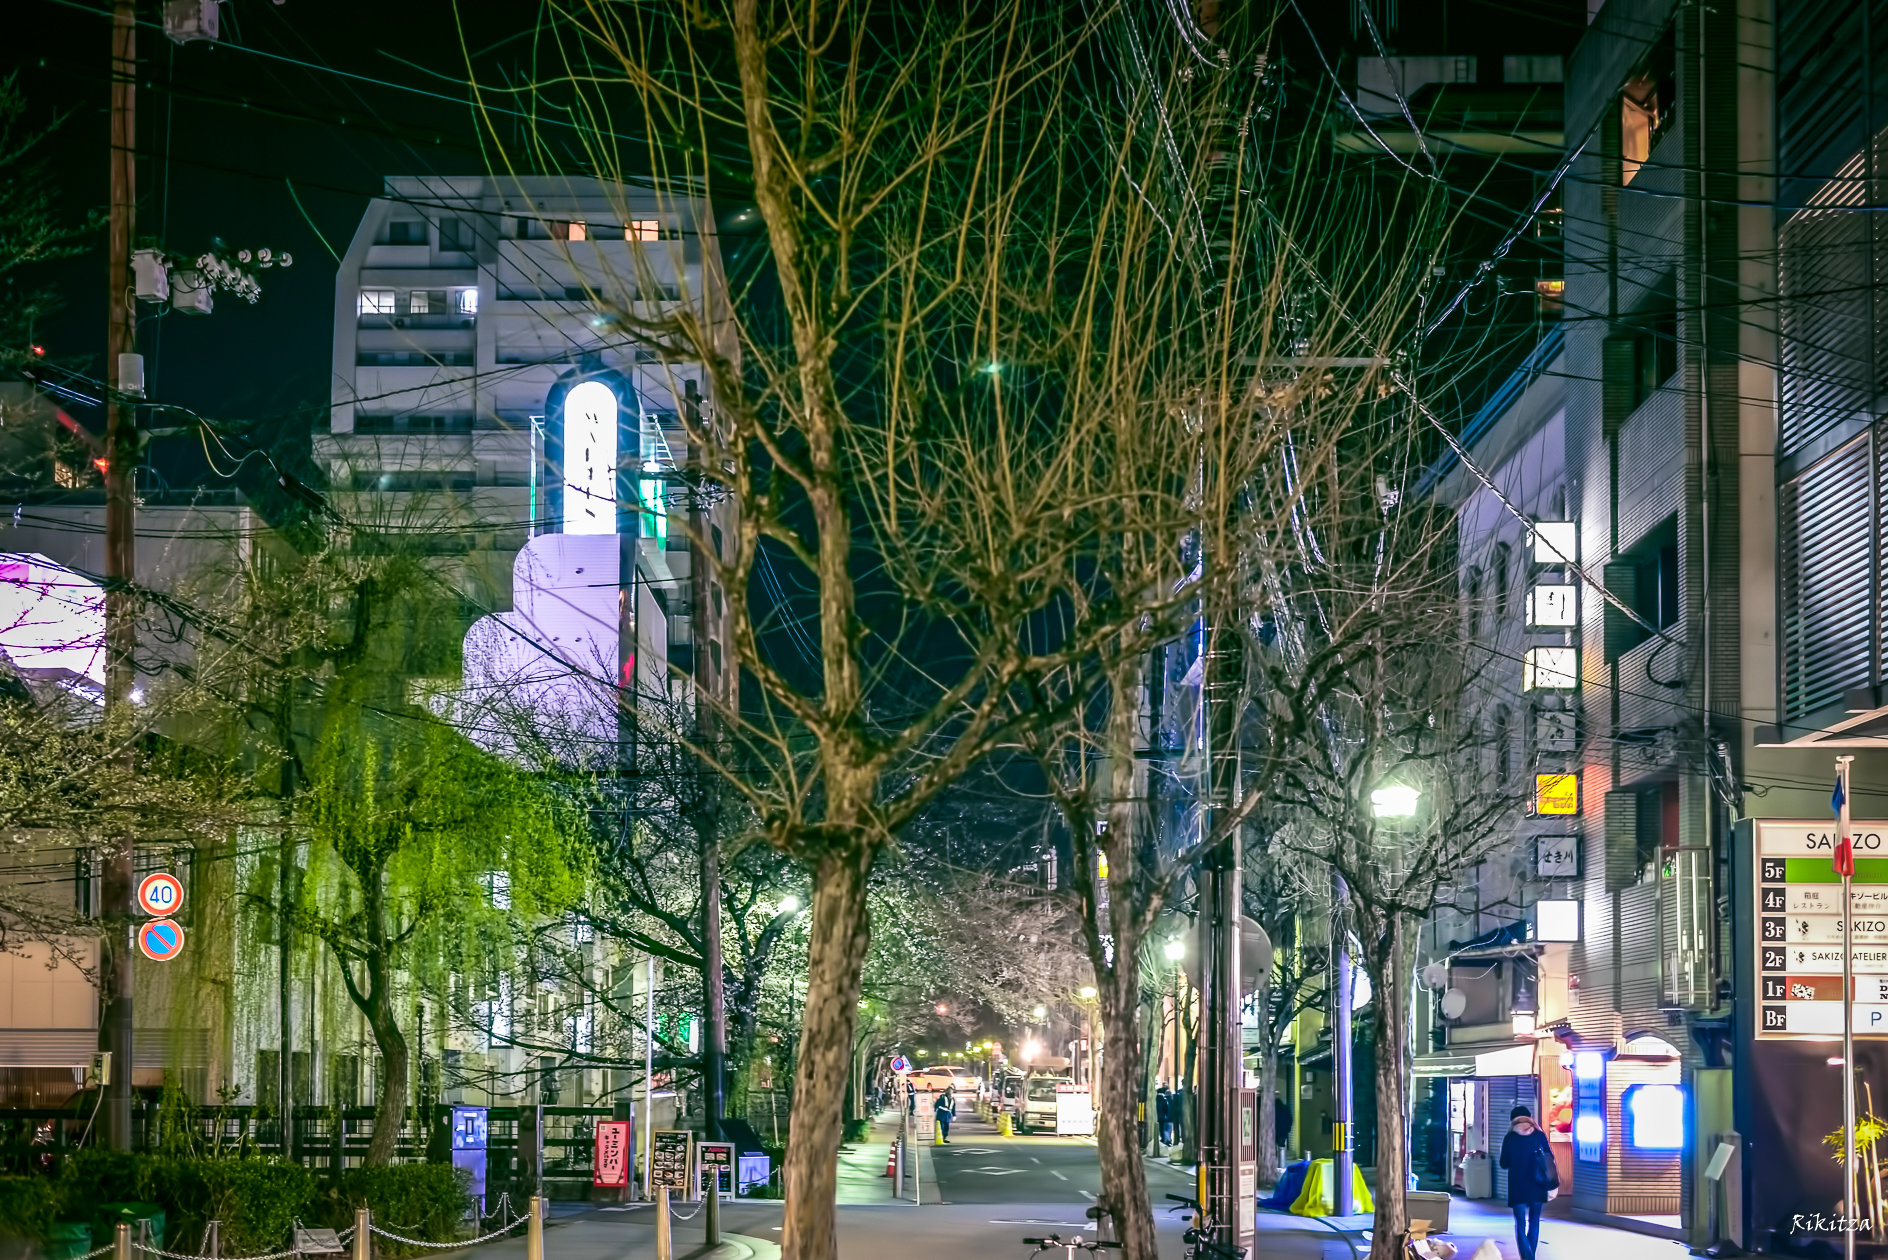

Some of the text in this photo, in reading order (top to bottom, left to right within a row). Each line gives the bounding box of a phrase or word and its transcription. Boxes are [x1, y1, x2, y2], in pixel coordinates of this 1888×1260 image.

[1806, 833, 1881, 849] SAZO
[1764, 862, 1785, 879] 5F
[149, 885, 172, 904] 40
[1764, 891, 1785, 908] 4F
[1764, 921, 1785, 938] 3F
[1836, 920, 1886, 932] SKIZO
[1764, 950, 1785, 967] 2F
[1852, 952, 1888, 961] ATELIER
[1765, 980, 1786, 997] 1F
[1765, 1010, 1786, 1027] BF
[610, 1127, 620, 1170] ユーミンバー
